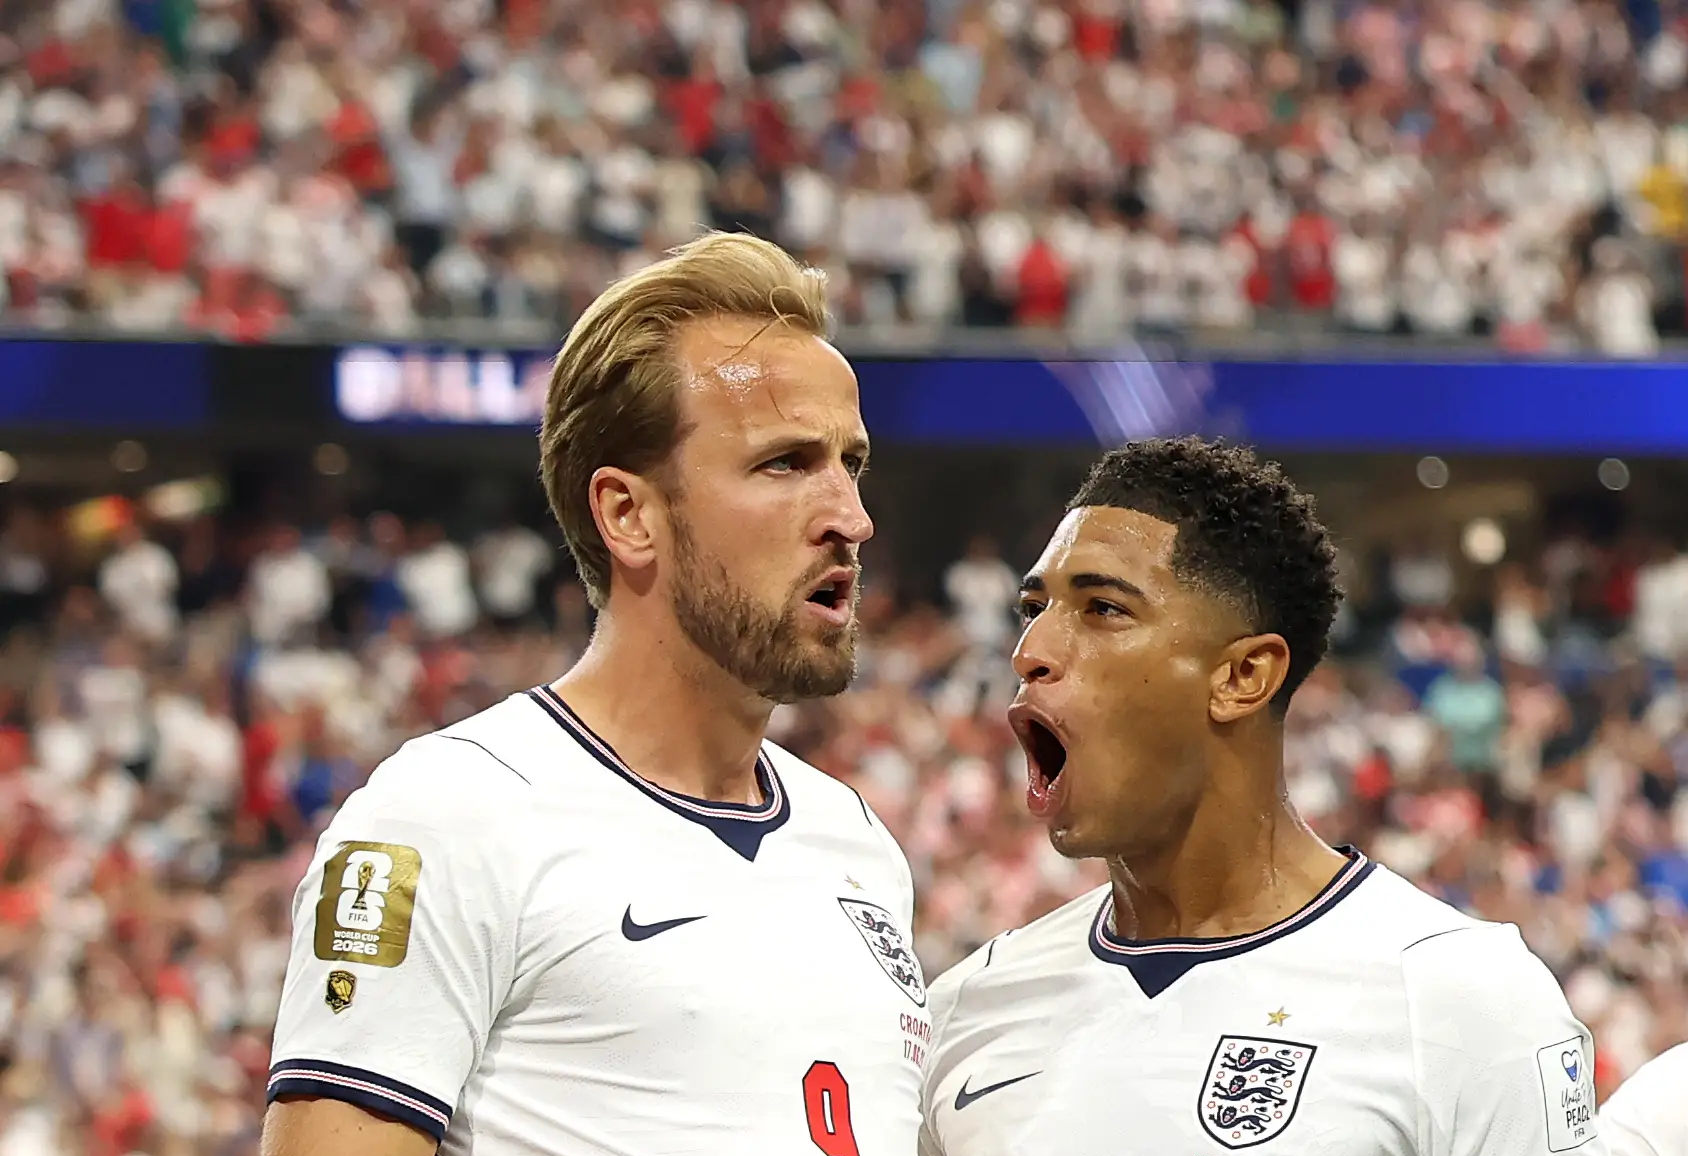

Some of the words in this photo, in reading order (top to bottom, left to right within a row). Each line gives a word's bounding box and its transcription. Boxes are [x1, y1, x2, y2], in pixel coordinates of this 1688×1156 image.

[348, 912, 369, 923] FIFA
[361, 932, 380, 942] CUP
[332, 939, 379, 956] 2026
